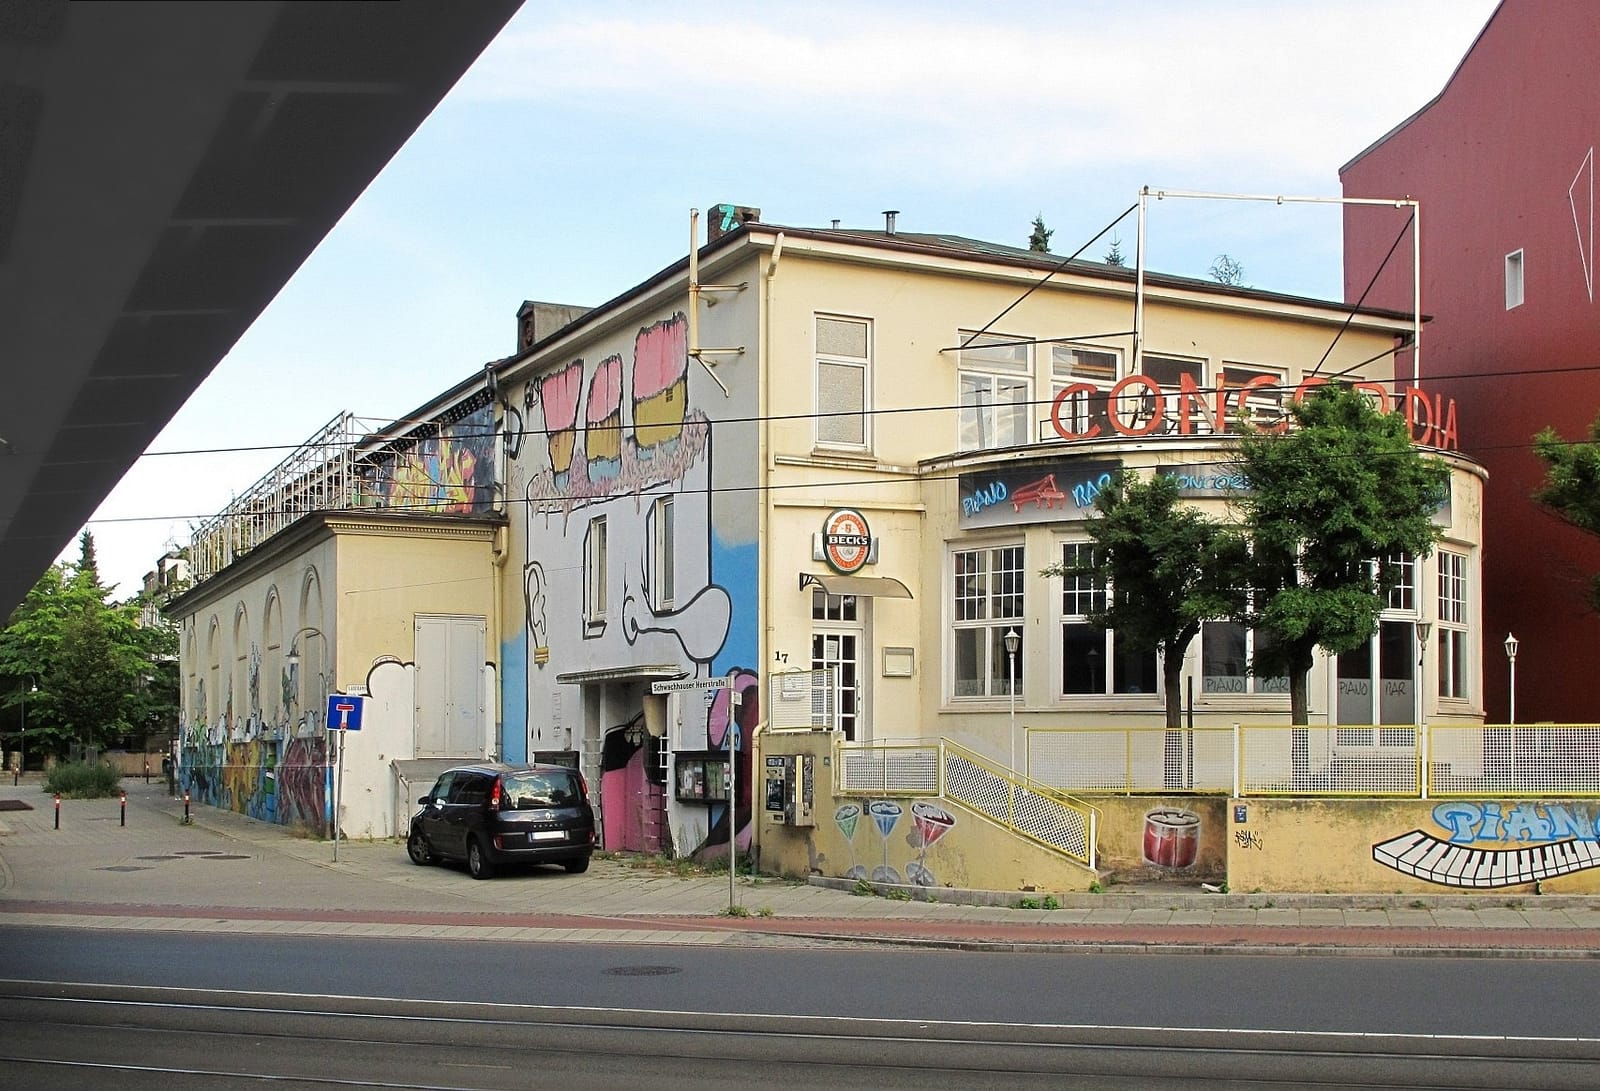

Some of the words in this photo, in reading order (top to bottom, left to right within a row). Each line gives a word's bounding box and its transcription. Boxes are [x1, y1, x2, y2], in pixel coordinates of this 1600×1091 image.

[963, 480, 1007, 518] PIANO
[775, 651, 789, 663] 17
[653, 682, 694, 691] Schwachhauser
[696, 679, 725, 688] Heerstraße
[1206, 678, 1243, 692] PIANO
[1339, 681, 1368, 695] PIANO
